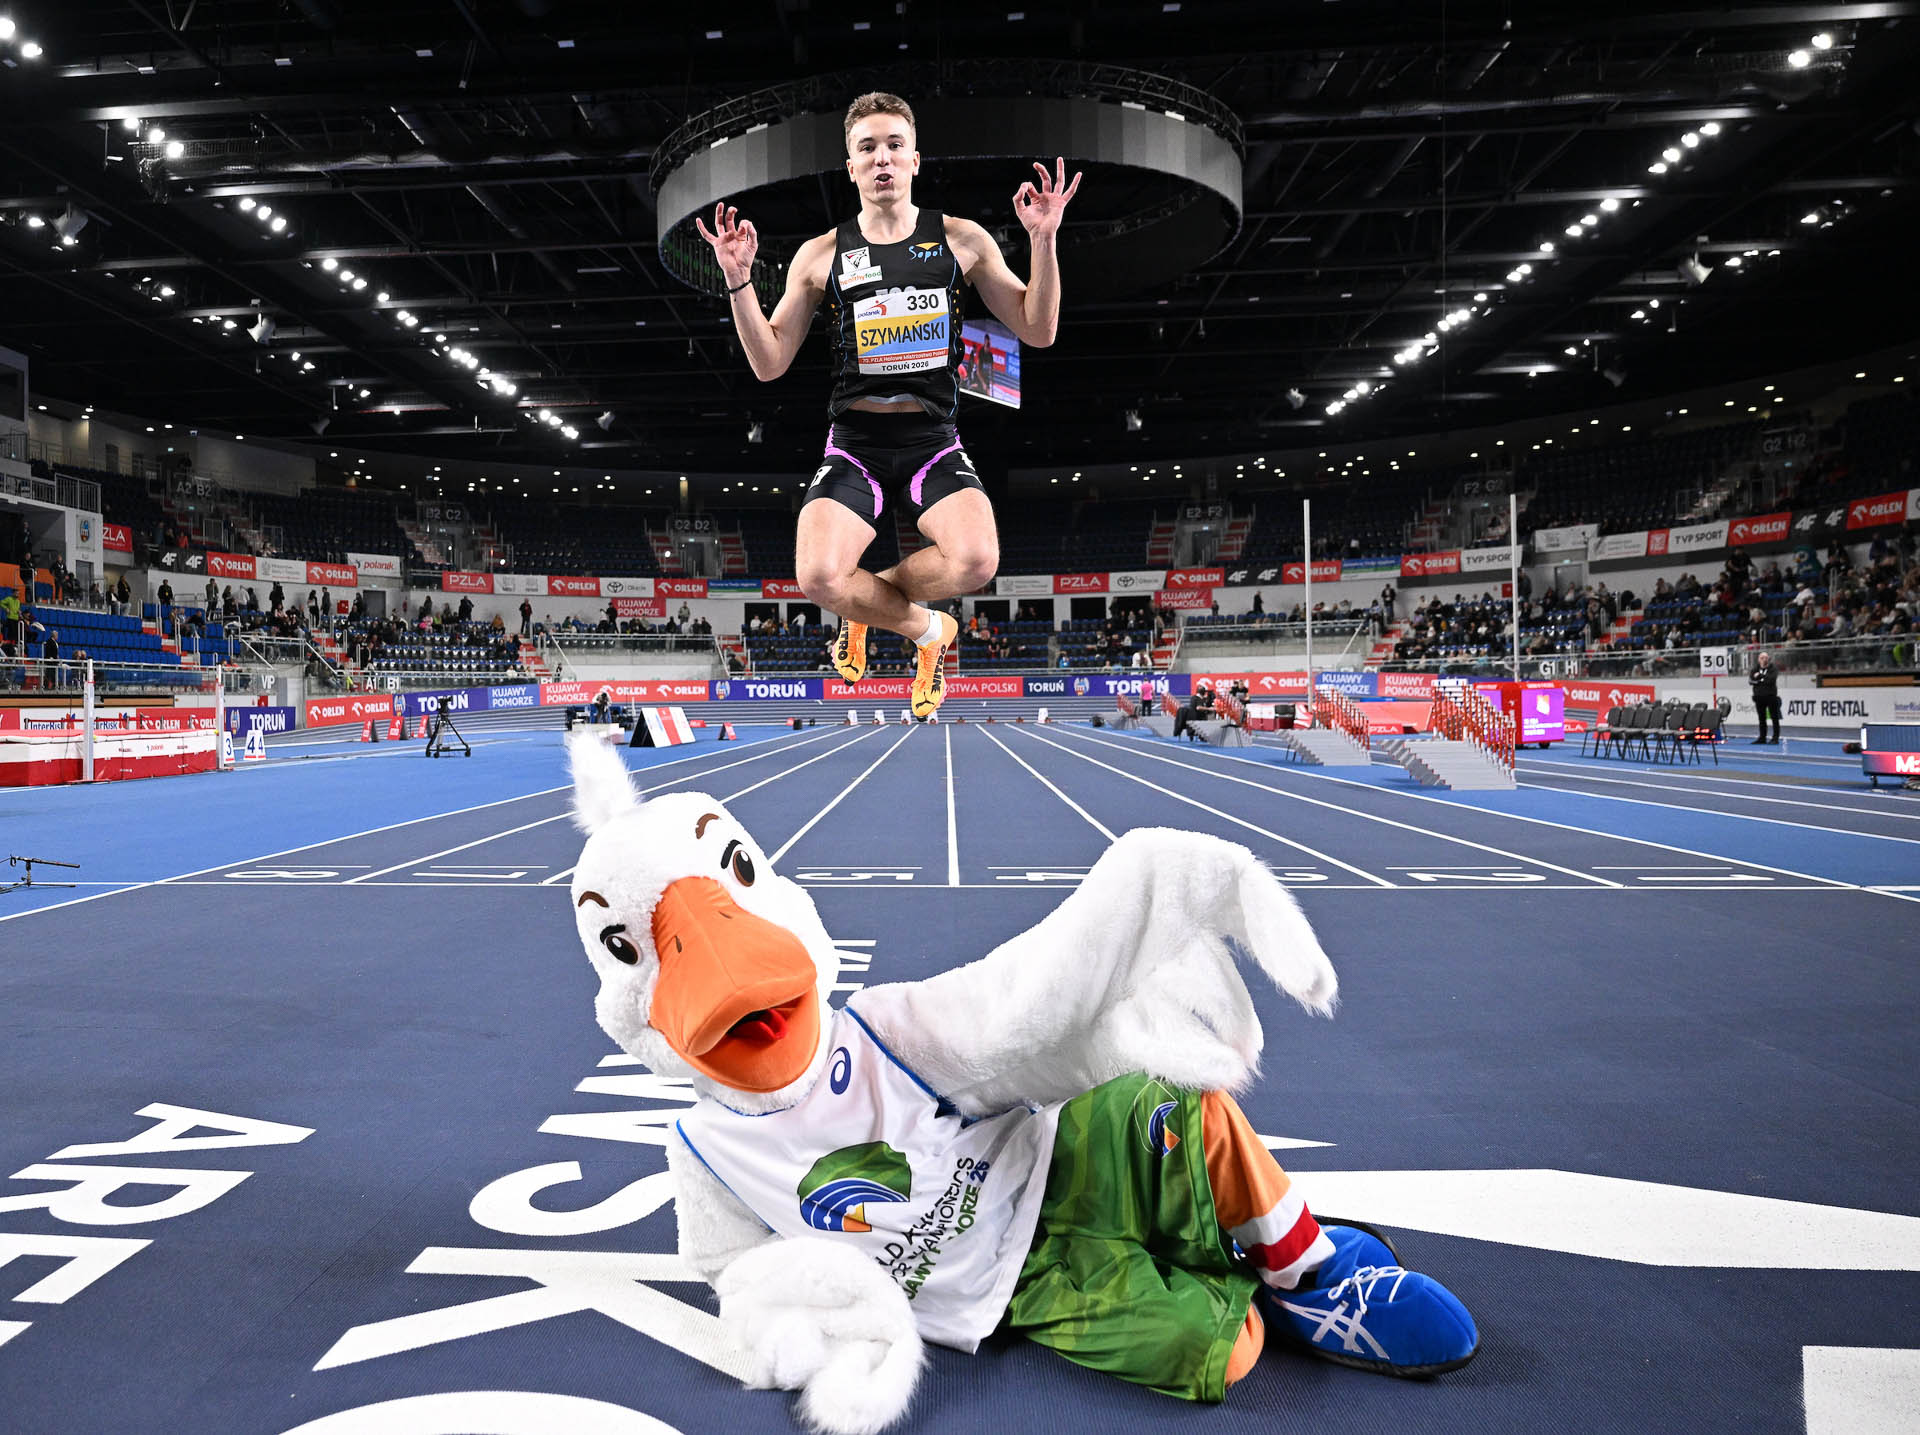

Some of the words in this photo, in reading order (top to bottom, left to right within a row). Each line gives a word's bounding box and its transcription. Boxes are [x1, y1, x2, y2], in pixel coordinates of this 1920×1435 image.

[909, 244, 943, 263] Sopot
[906, 293, 939, 311] 330
[860, 320, 945, 347] SZYMAŃSKI
[882, 361, 910, 372] TORUŃ
[911, 360, 929, 369] 2026
[1869, 501, 1904, 516] ORLEN
[1751, 521, 1786, 535] ORLEN
[1675, 533, 1693, 544] TVP
[1694, 530, 1724, 543] SPORT
[161, 552, 177, 565] 4F
[185, 555, 203, 568] 4F
[363, 558, 395, 570] polanik
[1424, 556, 1457, 569] ORLEN
[1466, 554, 1483, 565] TVP
[1485, 553, 1511, 564] SPOR
[226, 558, 253, 572] ORLEN
[325, 567, 353, 580] ORLEN
[1189, 573, 1220, 583] ORLEN
[1228, 570, 1247, 582] 4F
[1257, 568, 1278, 581] 4F
[450, 574, 487, 587] PZLA
[567, 580, 597, 591] ORLEN
[1060, 576, 1101, 588] PZLA
[674, 583, 704, 593] ORLEN
[1160, 590, 1200, 600] KUJAWY
[617, 599, 653, 608] KUJAWY
[617, 607, 660, 617] POMORZE
[1539, 661, 1556, 676] G1
[1565, 660, 1578, 675] H1
[260, 674, 275, 689] VIP
[365, 676, 377, 690] A1
[387, 676, 399, 690] B1
[1321, 673, 1363, 684] KUJAWY
[1384, 675, 1425, 686] KUJAWY
[492, 686, 526, 698] KUJAWY
[546, 683, 581, 693] KUJAWY
[616, 686, 647, 696] ORLEN
[674, 685, 706, 696] ORLEN
[746, 680, 806, 698] TORUŃ
[831, 685, 856, 695] PZLA
[858, 684, 905, 694] HALOWE
[981, 682, 1017, 693] POLSKI
[1028, 680, 1065, 693] TORUŃ
[1384, 686, 1431, 697] POMORZE
[492, 695, 534, 707] POMORZE
[546, 692, 589, 704] POMORZE
[1571, 689, 1600, 701] ORLEN
[321, 706, 345, 718] ORLEN
[364, 702, 390, 713] ORLEN
[1788, 701, 1816, 716] ATUT
[1822, 701, 1869, 717] RENTAL
[199, 719, 217, 730] ORLE
[250, 709, 286, 731] TORUŃ
[225, 737, 232, 756] 3
[247, 735, 255, 754] 4
